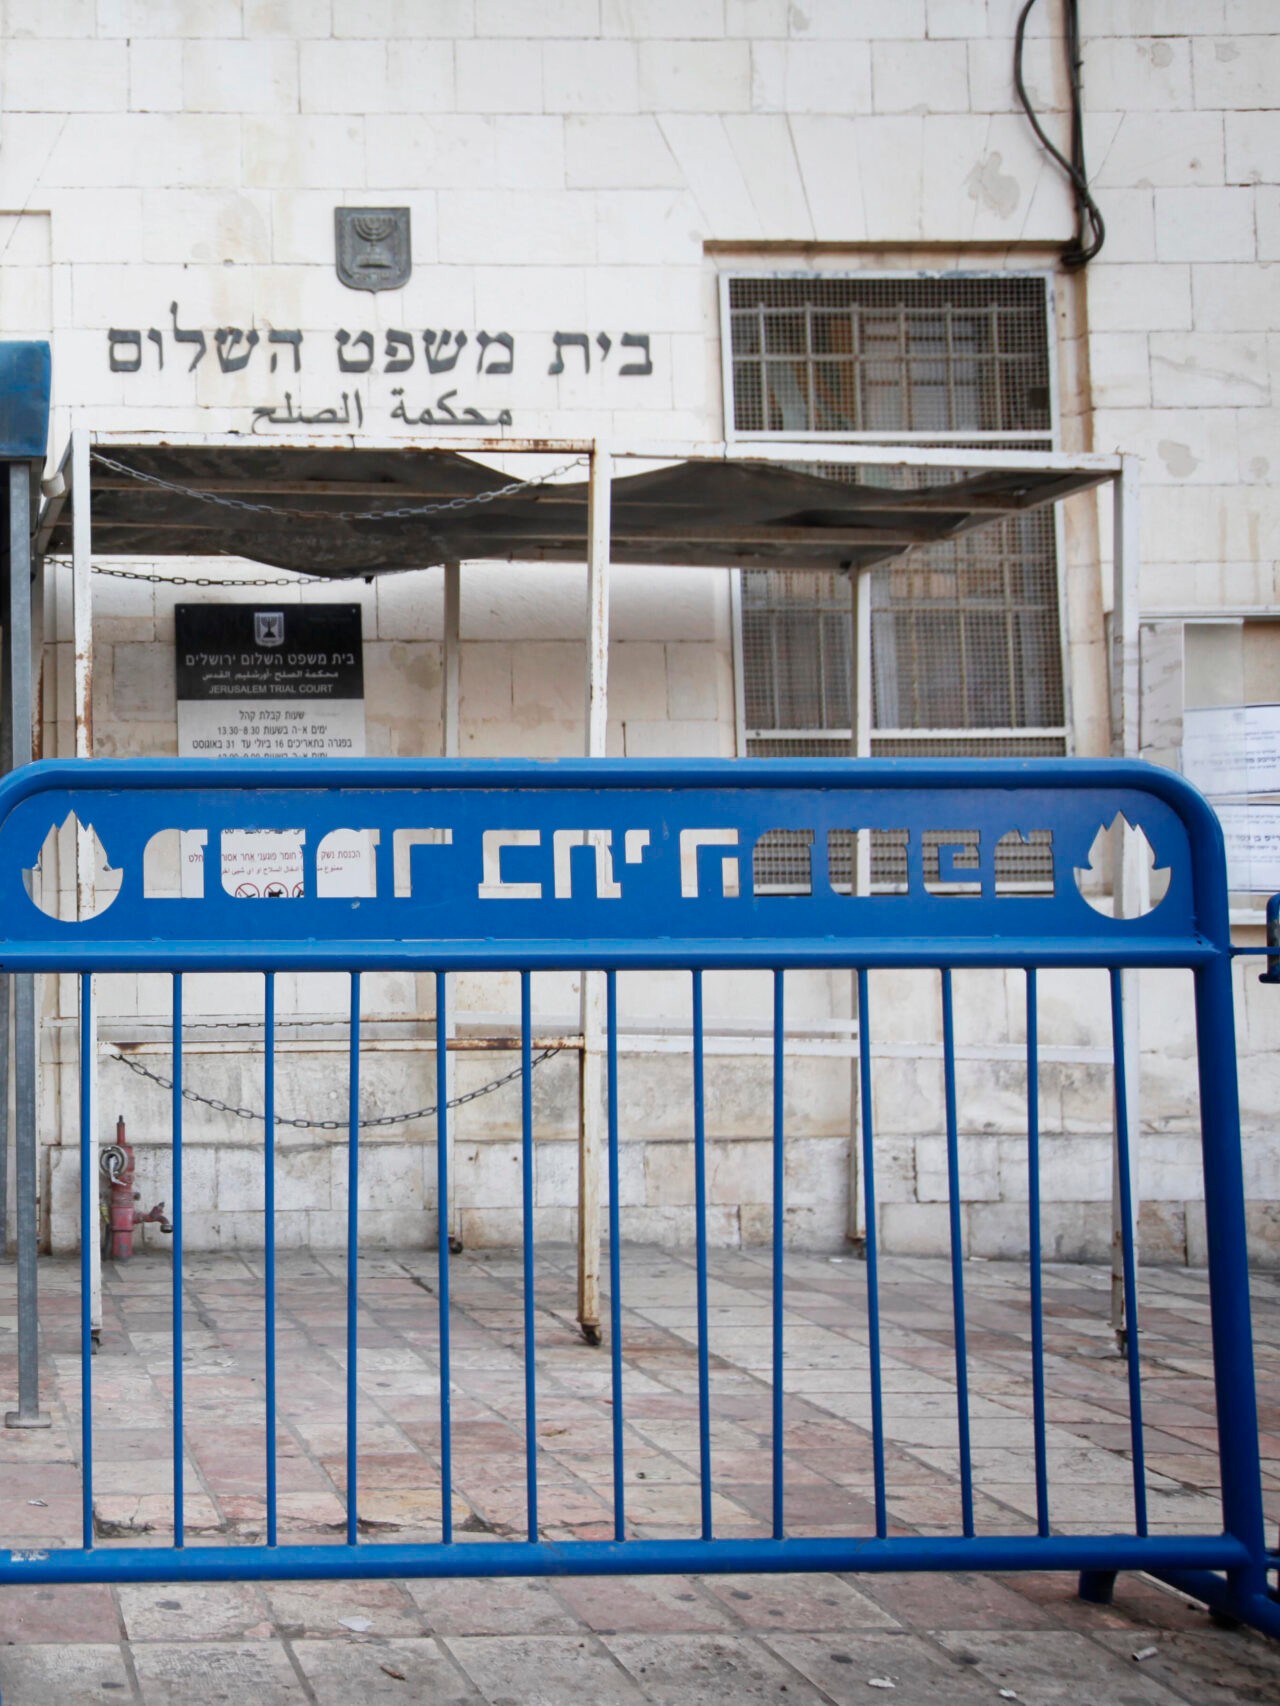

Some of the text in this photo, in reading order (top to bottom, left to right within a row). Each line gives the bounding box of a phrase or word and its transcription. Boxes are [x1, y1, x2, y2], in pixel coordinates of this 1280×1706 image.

[109, 301, 654, 376] בית משפט השלום
[251, 388, 513, 434] محكمة الصلح
[186, 652, 355, 667] בית משפט השלום ירושלים
[275, 671, 302, 681] الصلح
[305, 671, 338, 679] محكمة
[209, 684, 333, 694] JERUSALEM TRIAL COURT
[239, 710, 305, 721] שעות קבלת קהל
[263, 726, 288, 735] בשעות
[311, 725, 327, 734] ימים
[226, 740, 235, 749] 31
[240, 739, 251, 748] עד
[254, 738, 271, 748] ביולי
[275, 740, 284, 748] 16
[288, 739, 325, 748] בתאריכים
[328, 739, 352, 748] בפגרה
[240, 853, 255, 861] אחר
[321, 851, 335, 861] נשק
